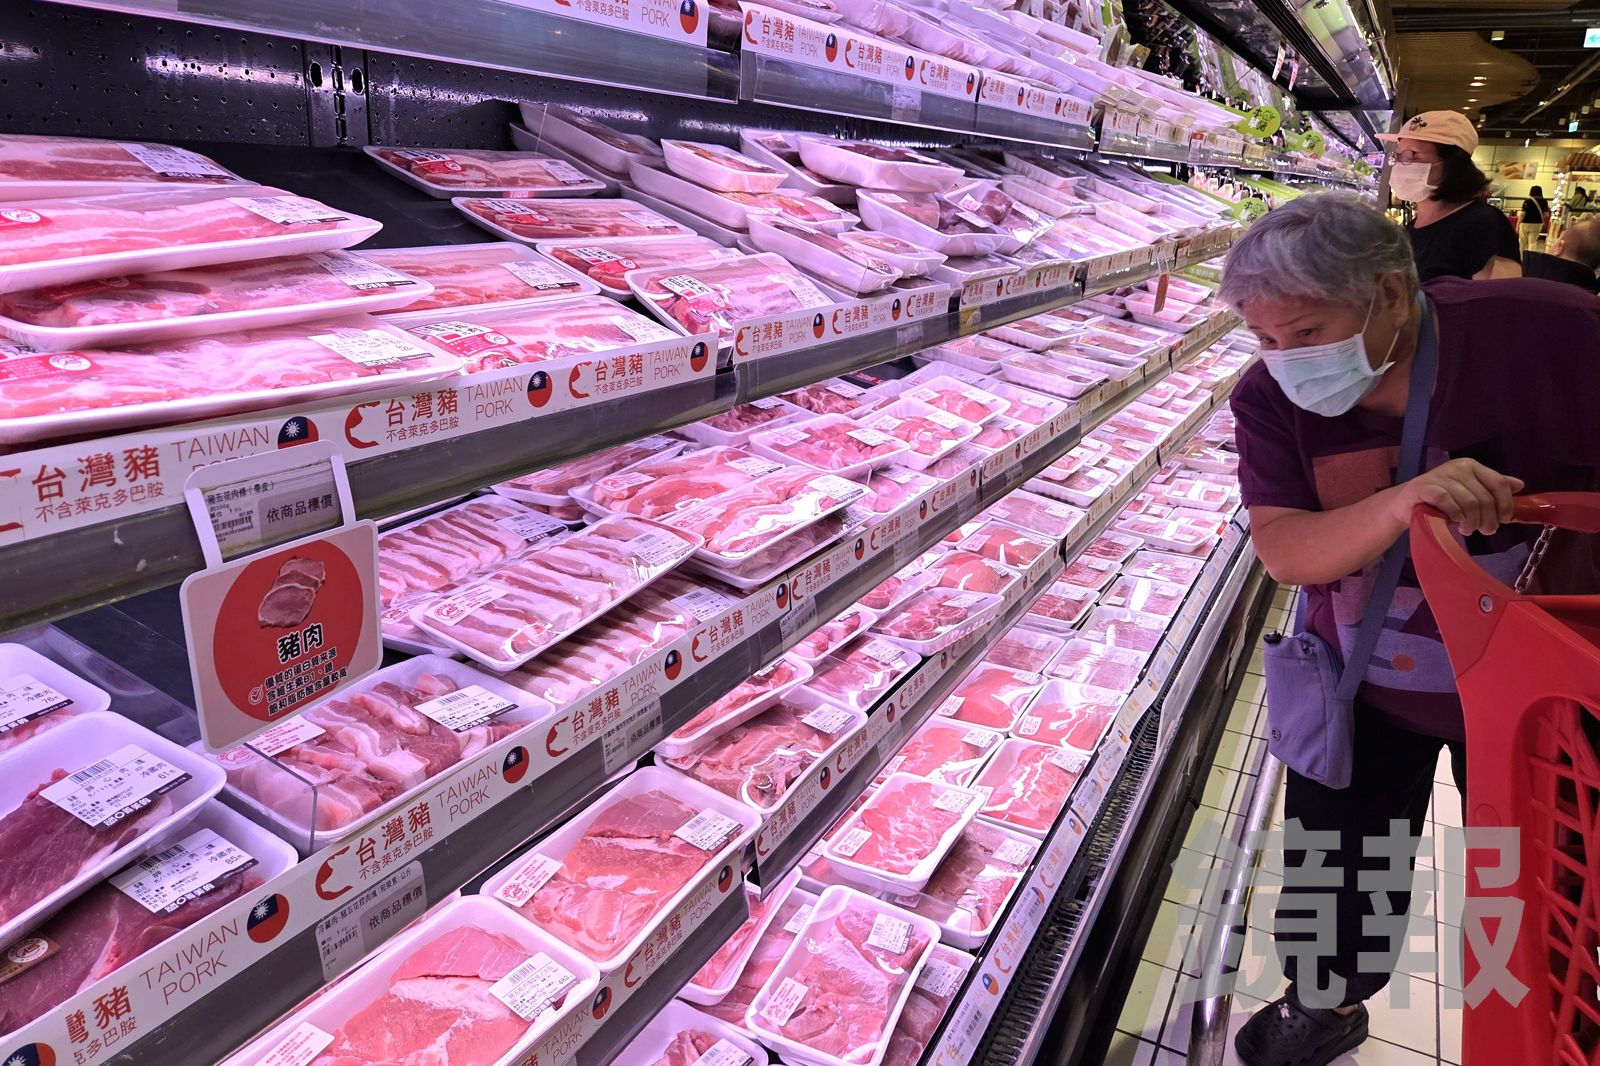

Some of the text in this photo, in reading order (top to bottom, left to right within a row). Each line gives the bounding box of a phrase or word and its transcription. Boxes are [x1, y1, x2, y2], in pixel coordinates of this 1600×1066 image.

[642, 6, 670, 28] PORK
[762, 13, 794, 42] 台灣豬
[799, 24, 825, 44] TAIWAN
[800, 42, 819, 58] PORK
[857, 41, 882, 64] 台灣豬
[844, 304, 868, 323] 台灣豬
[870, 300, 890, 314] TAIWAN
[873, 313, 888, 324] PORK
[752, 320, 783, 344] 台灣豬
[786, 316, 812, 330] TAIWAN
[789, 332, 808, 344] PORK
[595, 353, 644, 382] 台灣豬
[648, 347, 688, 366] TAIWAN
[654, 362, 682, 380] PORK
[464, 376, 522, 402] TAIWAN
[594, 376, 644, 396] 不含萊克多巴胺
[386, 389, 458, 428] 台灣豬
[475, 398, 514, 422] PORK
[170, 424, 269, 462] TAIWAN
[386, 416, 460, 444] 不含萊克多巴胺
[32, 444, 162, 503] 台灣豬
[35, 480, 164, 523] 不含萊克多巴胺
[266, 493, 333, 524] 依商品標價
[880, 515, 902, 537] 台灣豬
[832, 545, 854, 564] TAIWAN
[835, 558, 850, 574] PORK
[804, 558, 831, 586] 台灣豬
[745, 592, 774, 616] TAIWAN
[752, 606, 770, 627] PORK
[708, 610, 744, 643] 台灣豬
[277, 622, 323, 664] 豬肉
[265, 648, 337, 690] 優質的蛋白質來源
[622, 662, 662, 694] TAIWAN
[268, 668, 347, 716] 飽和脂肪酸含量較高
[630, 680, 658, 704] PORK
[572, 687, 620, 734] 台灣豬
[572, 708, 621, 746] 不含萊克多巴胺
[436, 760, 498, 808] TAIWAN
[449, 785, 490, 822] PORK
[770, 800, 796, 838] 台灣豬
[356, 802, 430, 866] 台灣豬
[358, 826, 434, 880] 不含萊克多巴胺
[684, 878, 716, 914] TAIWAN
[690, 899, 713, 926] PORK
[644, 915, 682, 962] 台灣豬
[138, 918, 238, 990] TAIWAN
[162, 951, 228, 1005] PORK
[542, 1004, 590, 1055] TAIWAN
[552, 1028, 583, 1066] PORK
